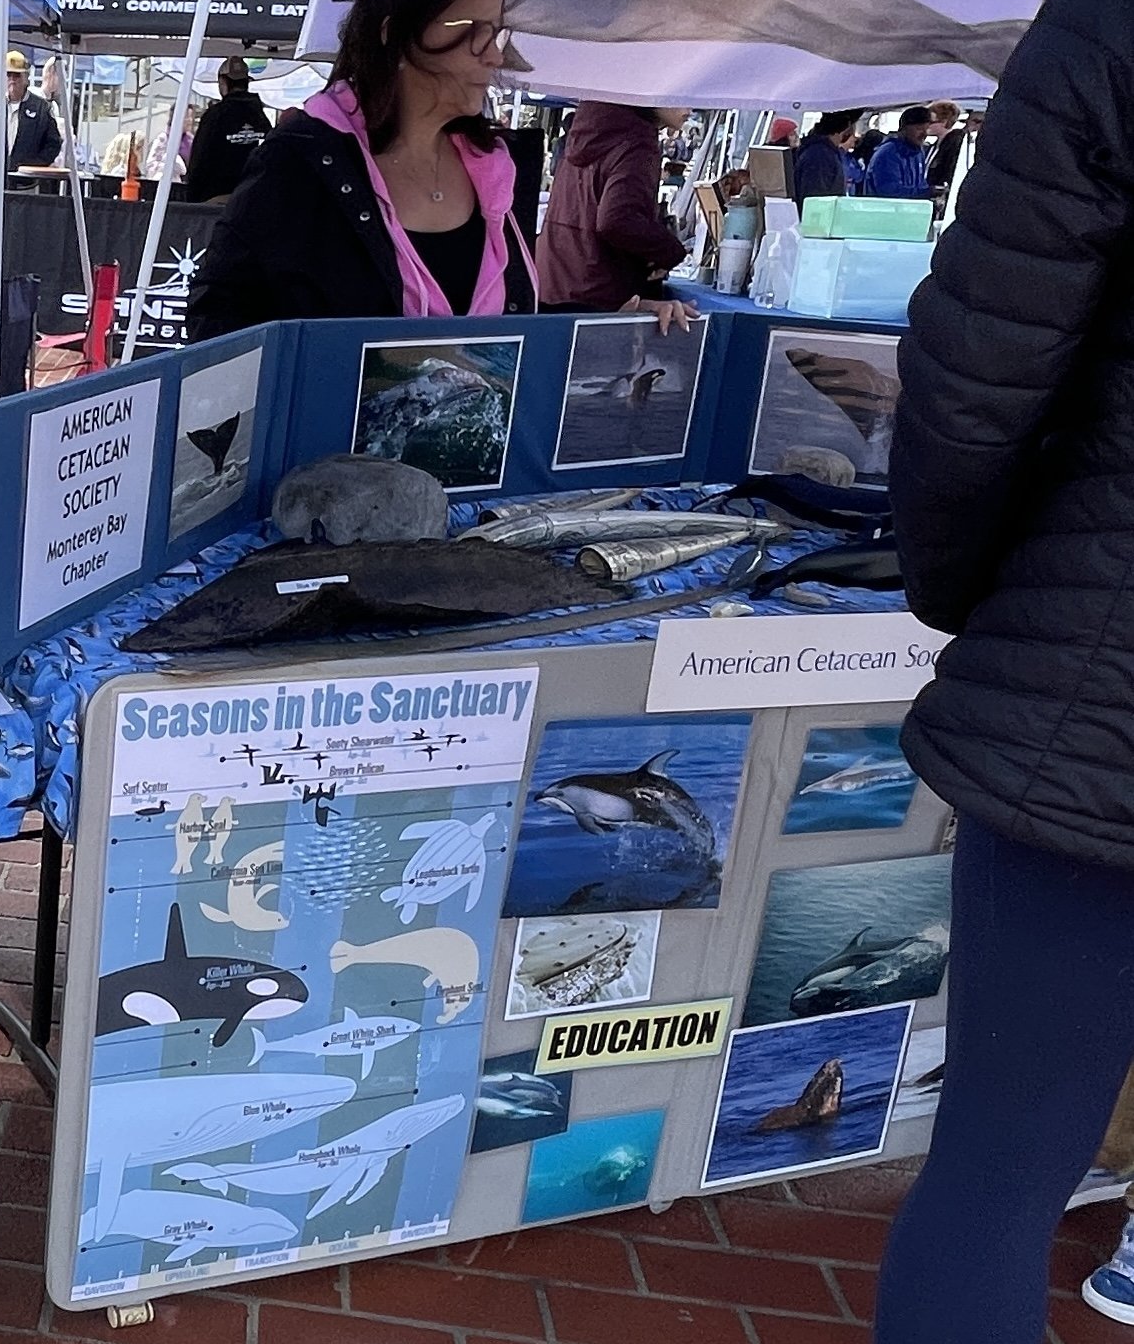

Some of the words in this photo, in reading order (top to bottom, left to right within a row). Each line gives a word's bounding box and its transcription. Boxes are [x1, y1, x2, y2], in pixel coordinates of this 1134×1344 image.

[126, 0, 249, 15] COMMECIAL
[60, 396, 134, 443] AMERICAN
[57, 434, 131, 482] CETACEAN
[62, 472, 123, 519] SOCIETY
[46, 521, 105, 564] Monterey
[107, 512, 129, 537] Bay
[62, 550, 110, 587] Chapter
[679, 648, 792, 678] American
[796, 646, 897, 673] Cetacean
[121, 696, 271, 743] Seasons
[274, 686, 306, 731] in
[311, 683, 363, 727] the
[368, 679, 534, 724] Sanctuary
[229, 963, 255, 976] Whale
[546, 1010, 722, 1061] EDUCATION
[262, 1101, 286, 1113] Whale
[338, 1143, 362, 1156] Whale
[183, 1220, 208, 1231] Whale
